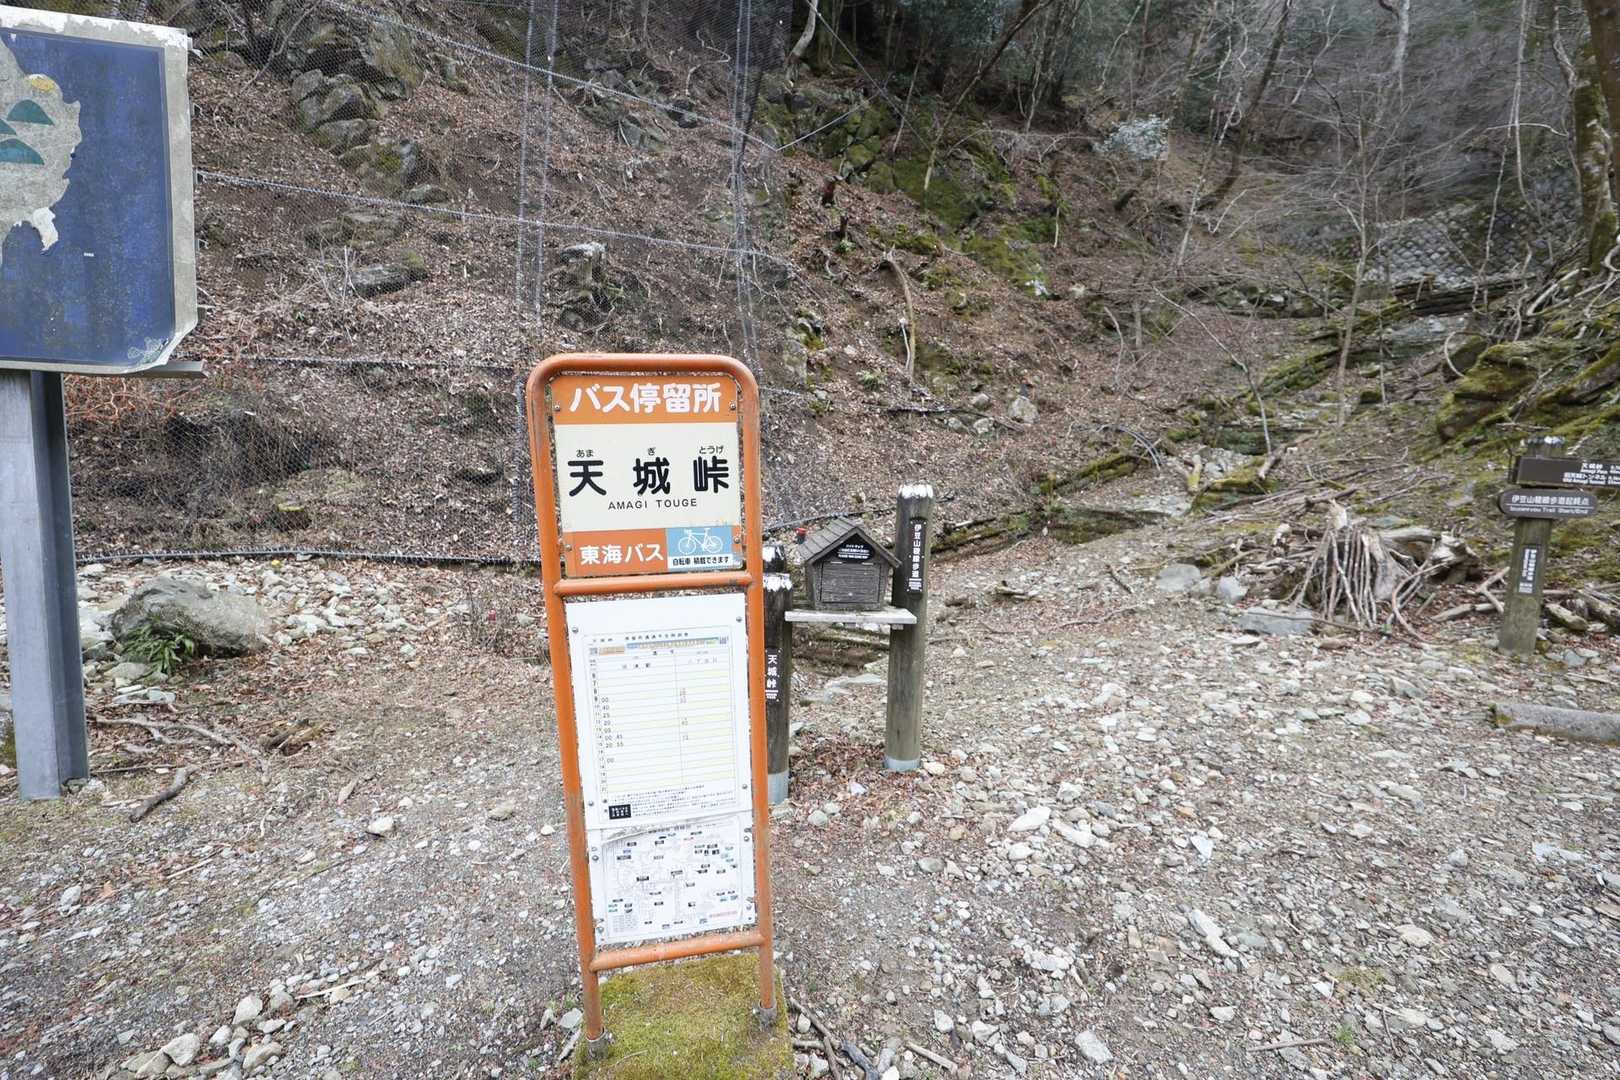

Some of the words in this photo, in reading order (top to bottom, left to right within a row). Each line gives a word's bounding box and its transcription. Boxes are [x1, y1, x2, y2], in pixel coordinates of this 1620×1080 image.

[569, 382, 721, 413] バス停留所
[576, 449, 594, 458] あま
[648, 447, 656, 456] ぎ
[699, 445, 724, 454] とうげ
[567, 456, 729, 497] 天城峠
[608, 500, 648, 510] AMAGI
[656, 498, 697, 509] TOUGE
[579, 543, 664, 565] 東海バス
[672, 557, 691, 566] 自転車
[766, 654, 778, 689] 天城峠
